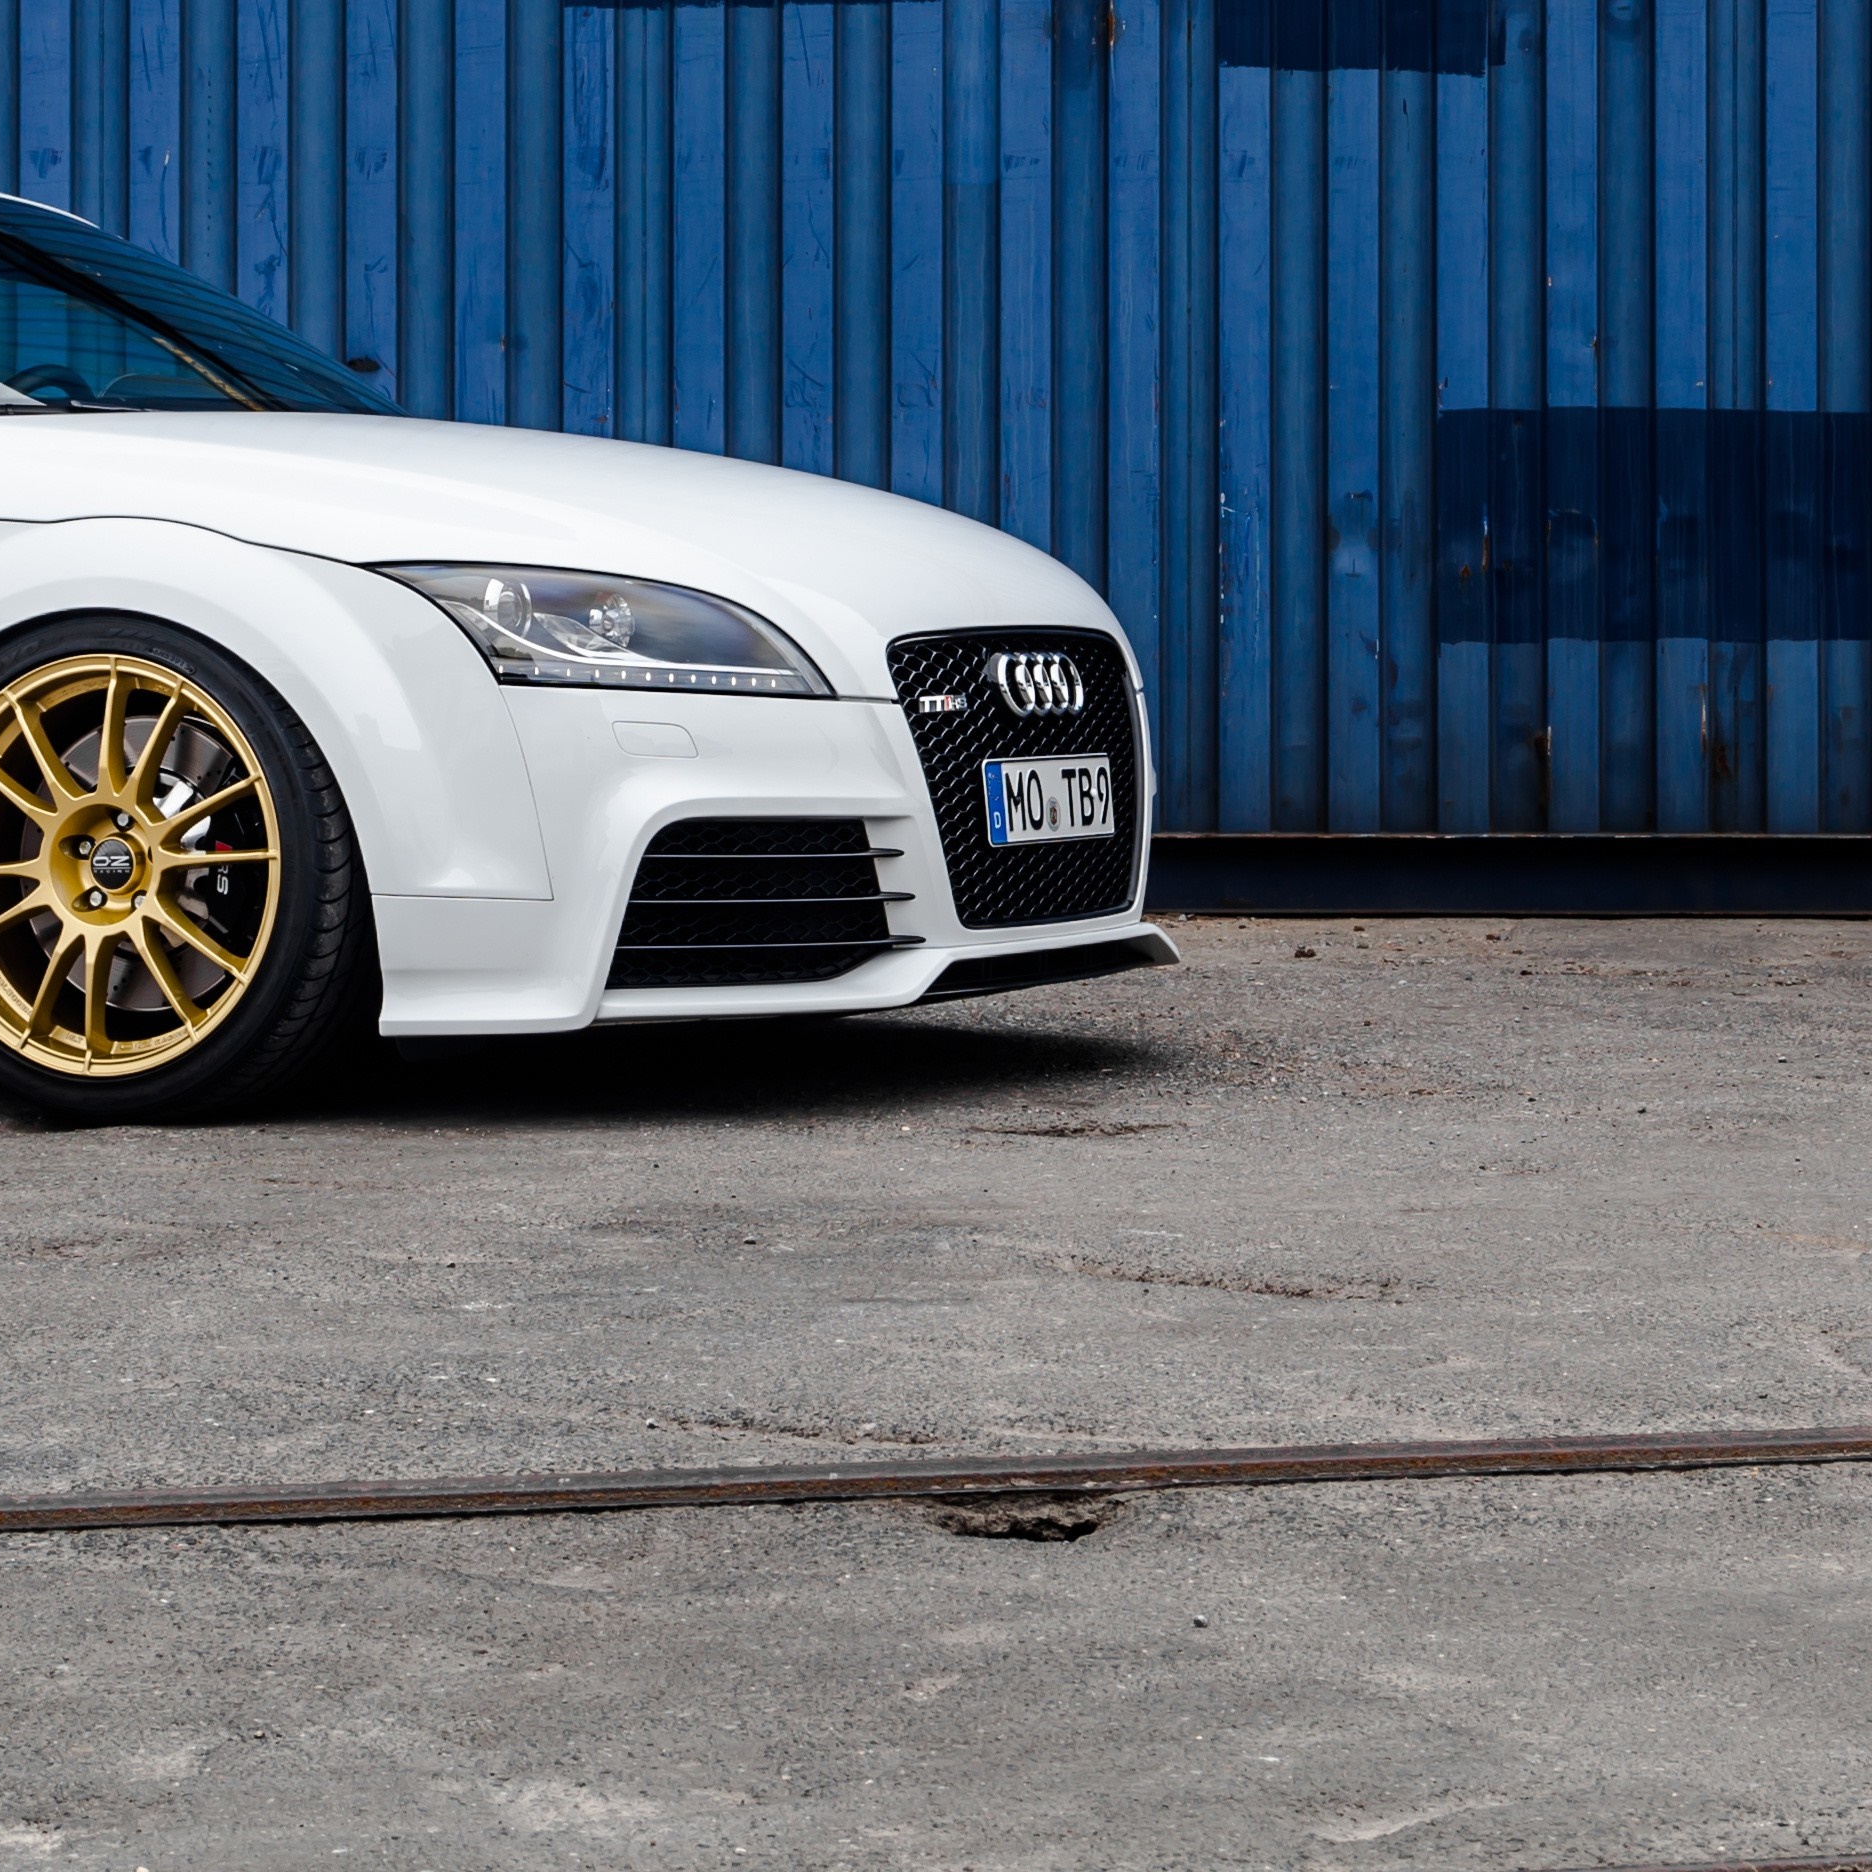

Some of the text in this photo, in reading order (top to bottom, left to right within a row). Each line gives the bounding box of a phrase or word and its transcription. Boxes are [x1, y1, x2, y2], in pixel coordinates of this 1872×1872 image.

[1005, 769, 1044, 832] MO
[993, 811, 1002, 829] D
[93, 855, 130, 867] OZ
